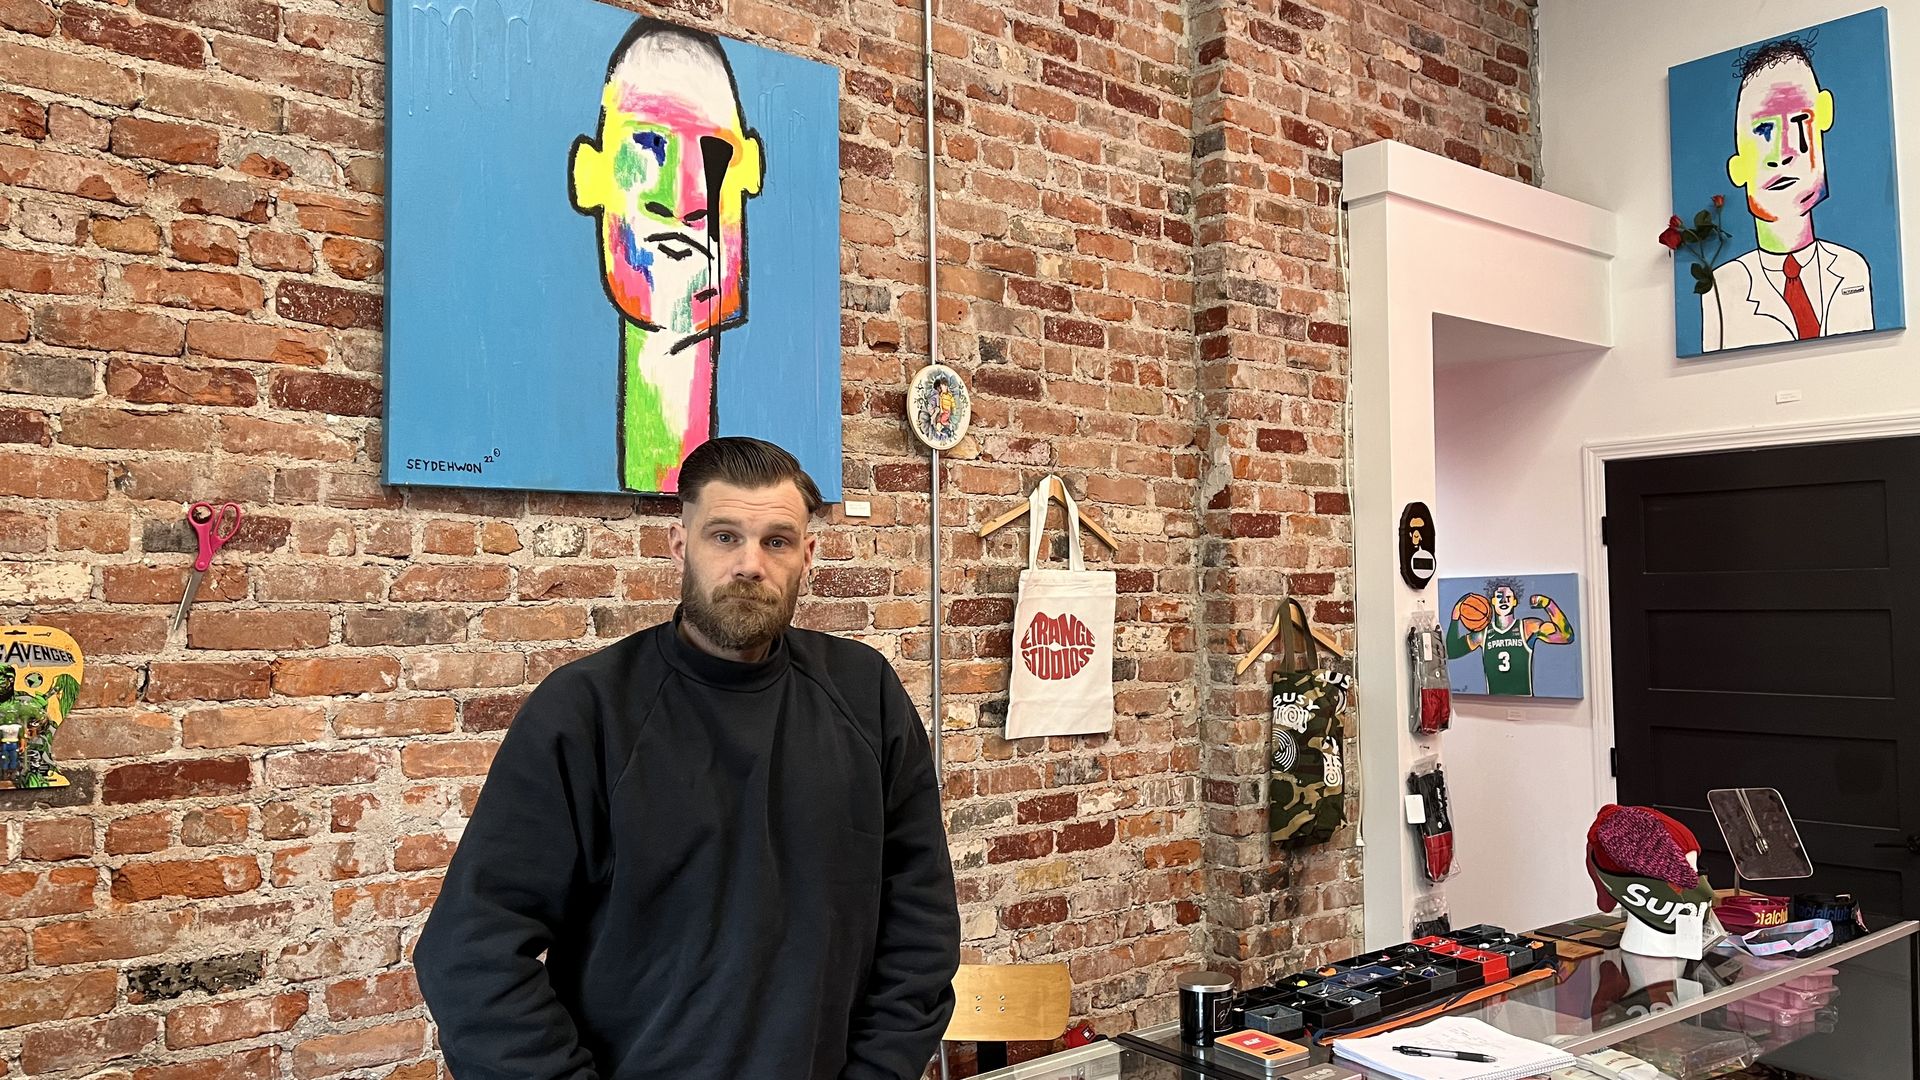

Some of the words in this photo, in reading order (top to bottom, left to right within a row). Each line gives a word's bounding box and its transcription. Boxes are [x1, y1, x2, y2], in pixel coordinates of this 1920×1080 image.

[406, 458, 482, 474] SEYDEHWON
[4, 641, 76, 663] AVENGER
[1487, 638, 1523, 650] SPARTANS
[1021, 646, 1094, 681] STUDIOS
[1498, 651, 1510, 672] 3
[1272, 692, 1320, 711] BUSY
